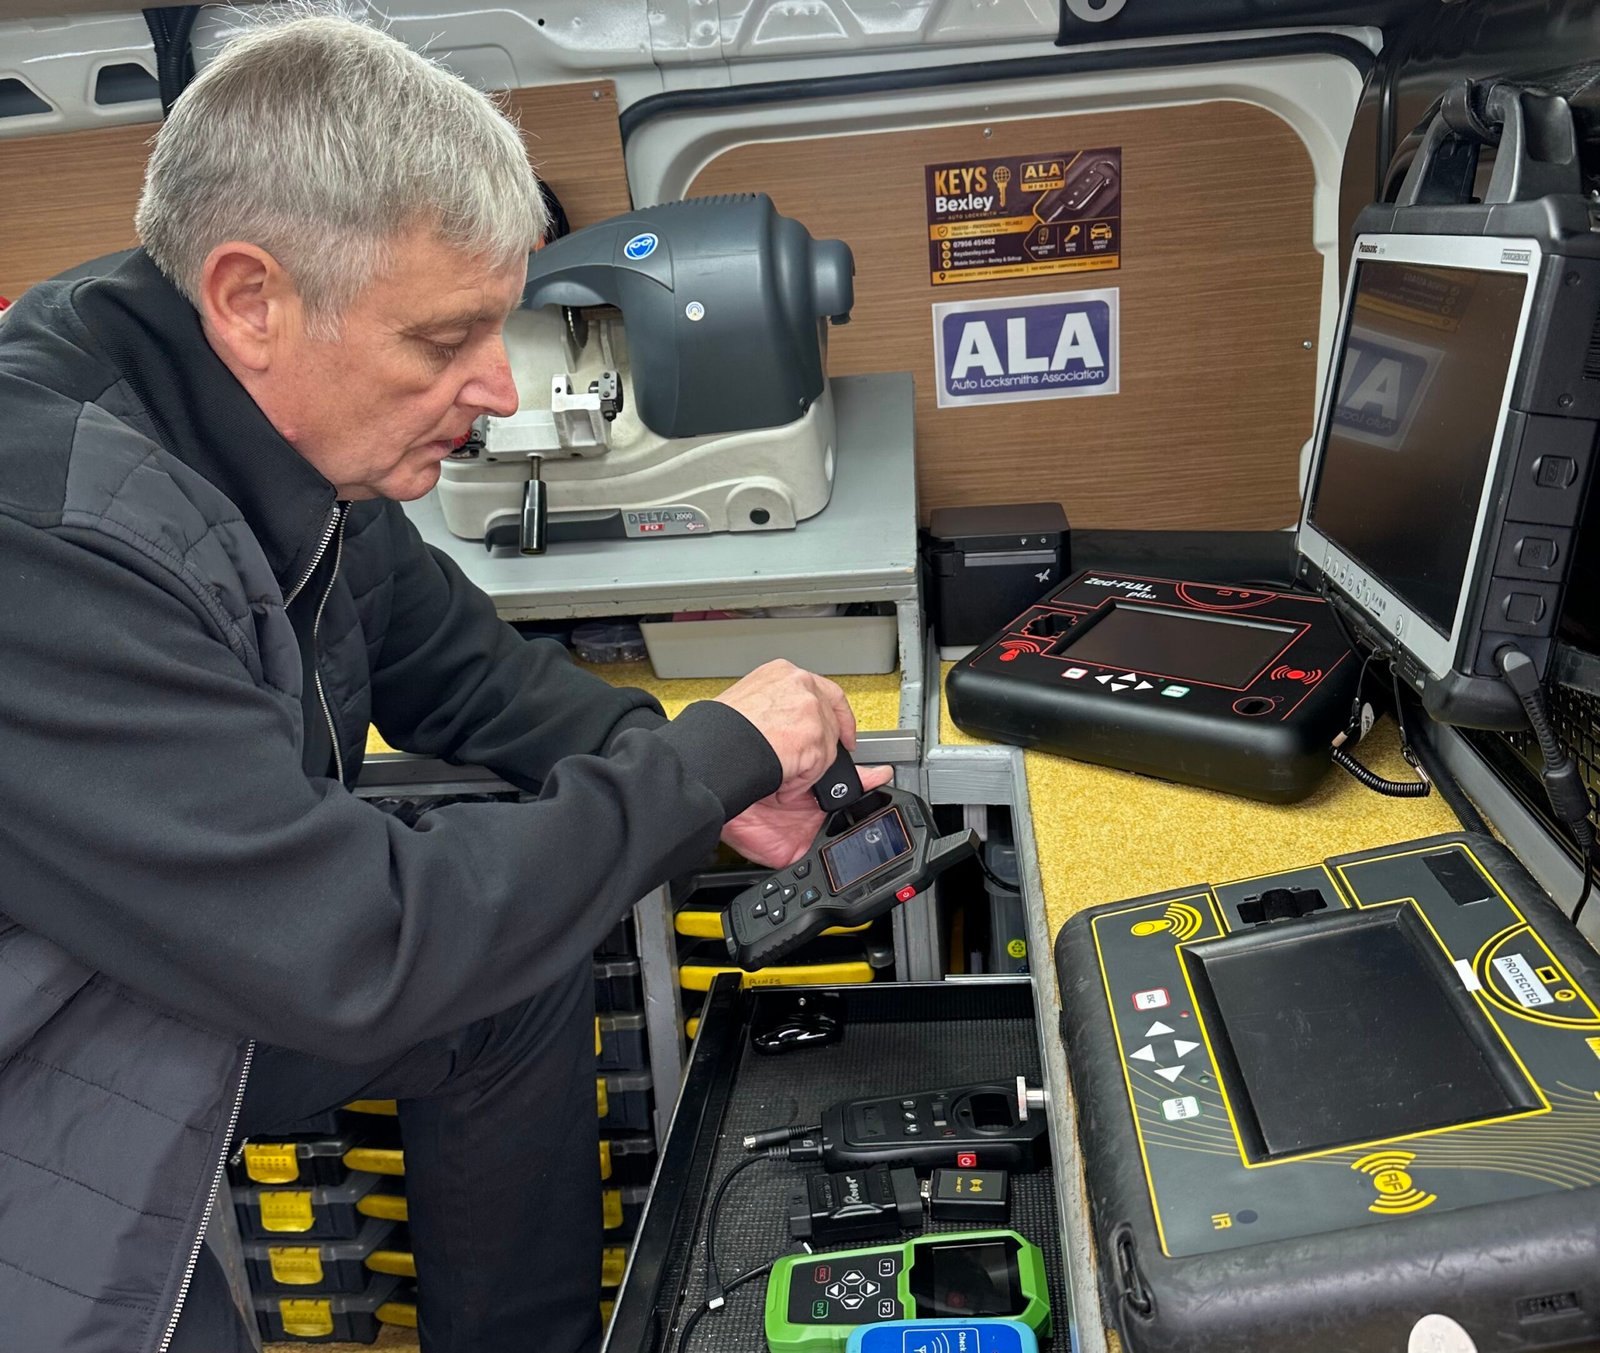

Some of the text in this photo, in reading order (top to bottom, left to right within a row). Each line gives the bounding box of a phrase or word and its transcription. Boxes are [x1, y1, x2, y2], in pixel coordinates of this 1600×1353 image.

[1024, 163, 1061, 179] ALA
[934, 166, 987, 196] KEYS
[935, 193, 994, 213] Bexley
[965, 211, 997, 219] LOCKSMITH
[951, 311, 1105, 380] ALA
[952, 369, 1105, 391] Auto Locksmiths Association
[628, 510, 672, 524] DELTA
[1084, 577, 1153, 592] Zed-FULL
[1125, 591, 1157, 599] plus
[1501, 957, 1542, 1005] PROTECTED
[1146, 993, 1156, 1004] ESC
[1174, 1098, 1187, 1118] ENTER
[1380, 1172, 1404, 1191] RF
[1211, 1212, 1232, 1230] IR
[882, 1262, 891, 1272] F1
[816, 1302, 824, 1315] ENT
[882, 1301, 891, 1314] F2
[958, 1331, 967, 1352] Check
